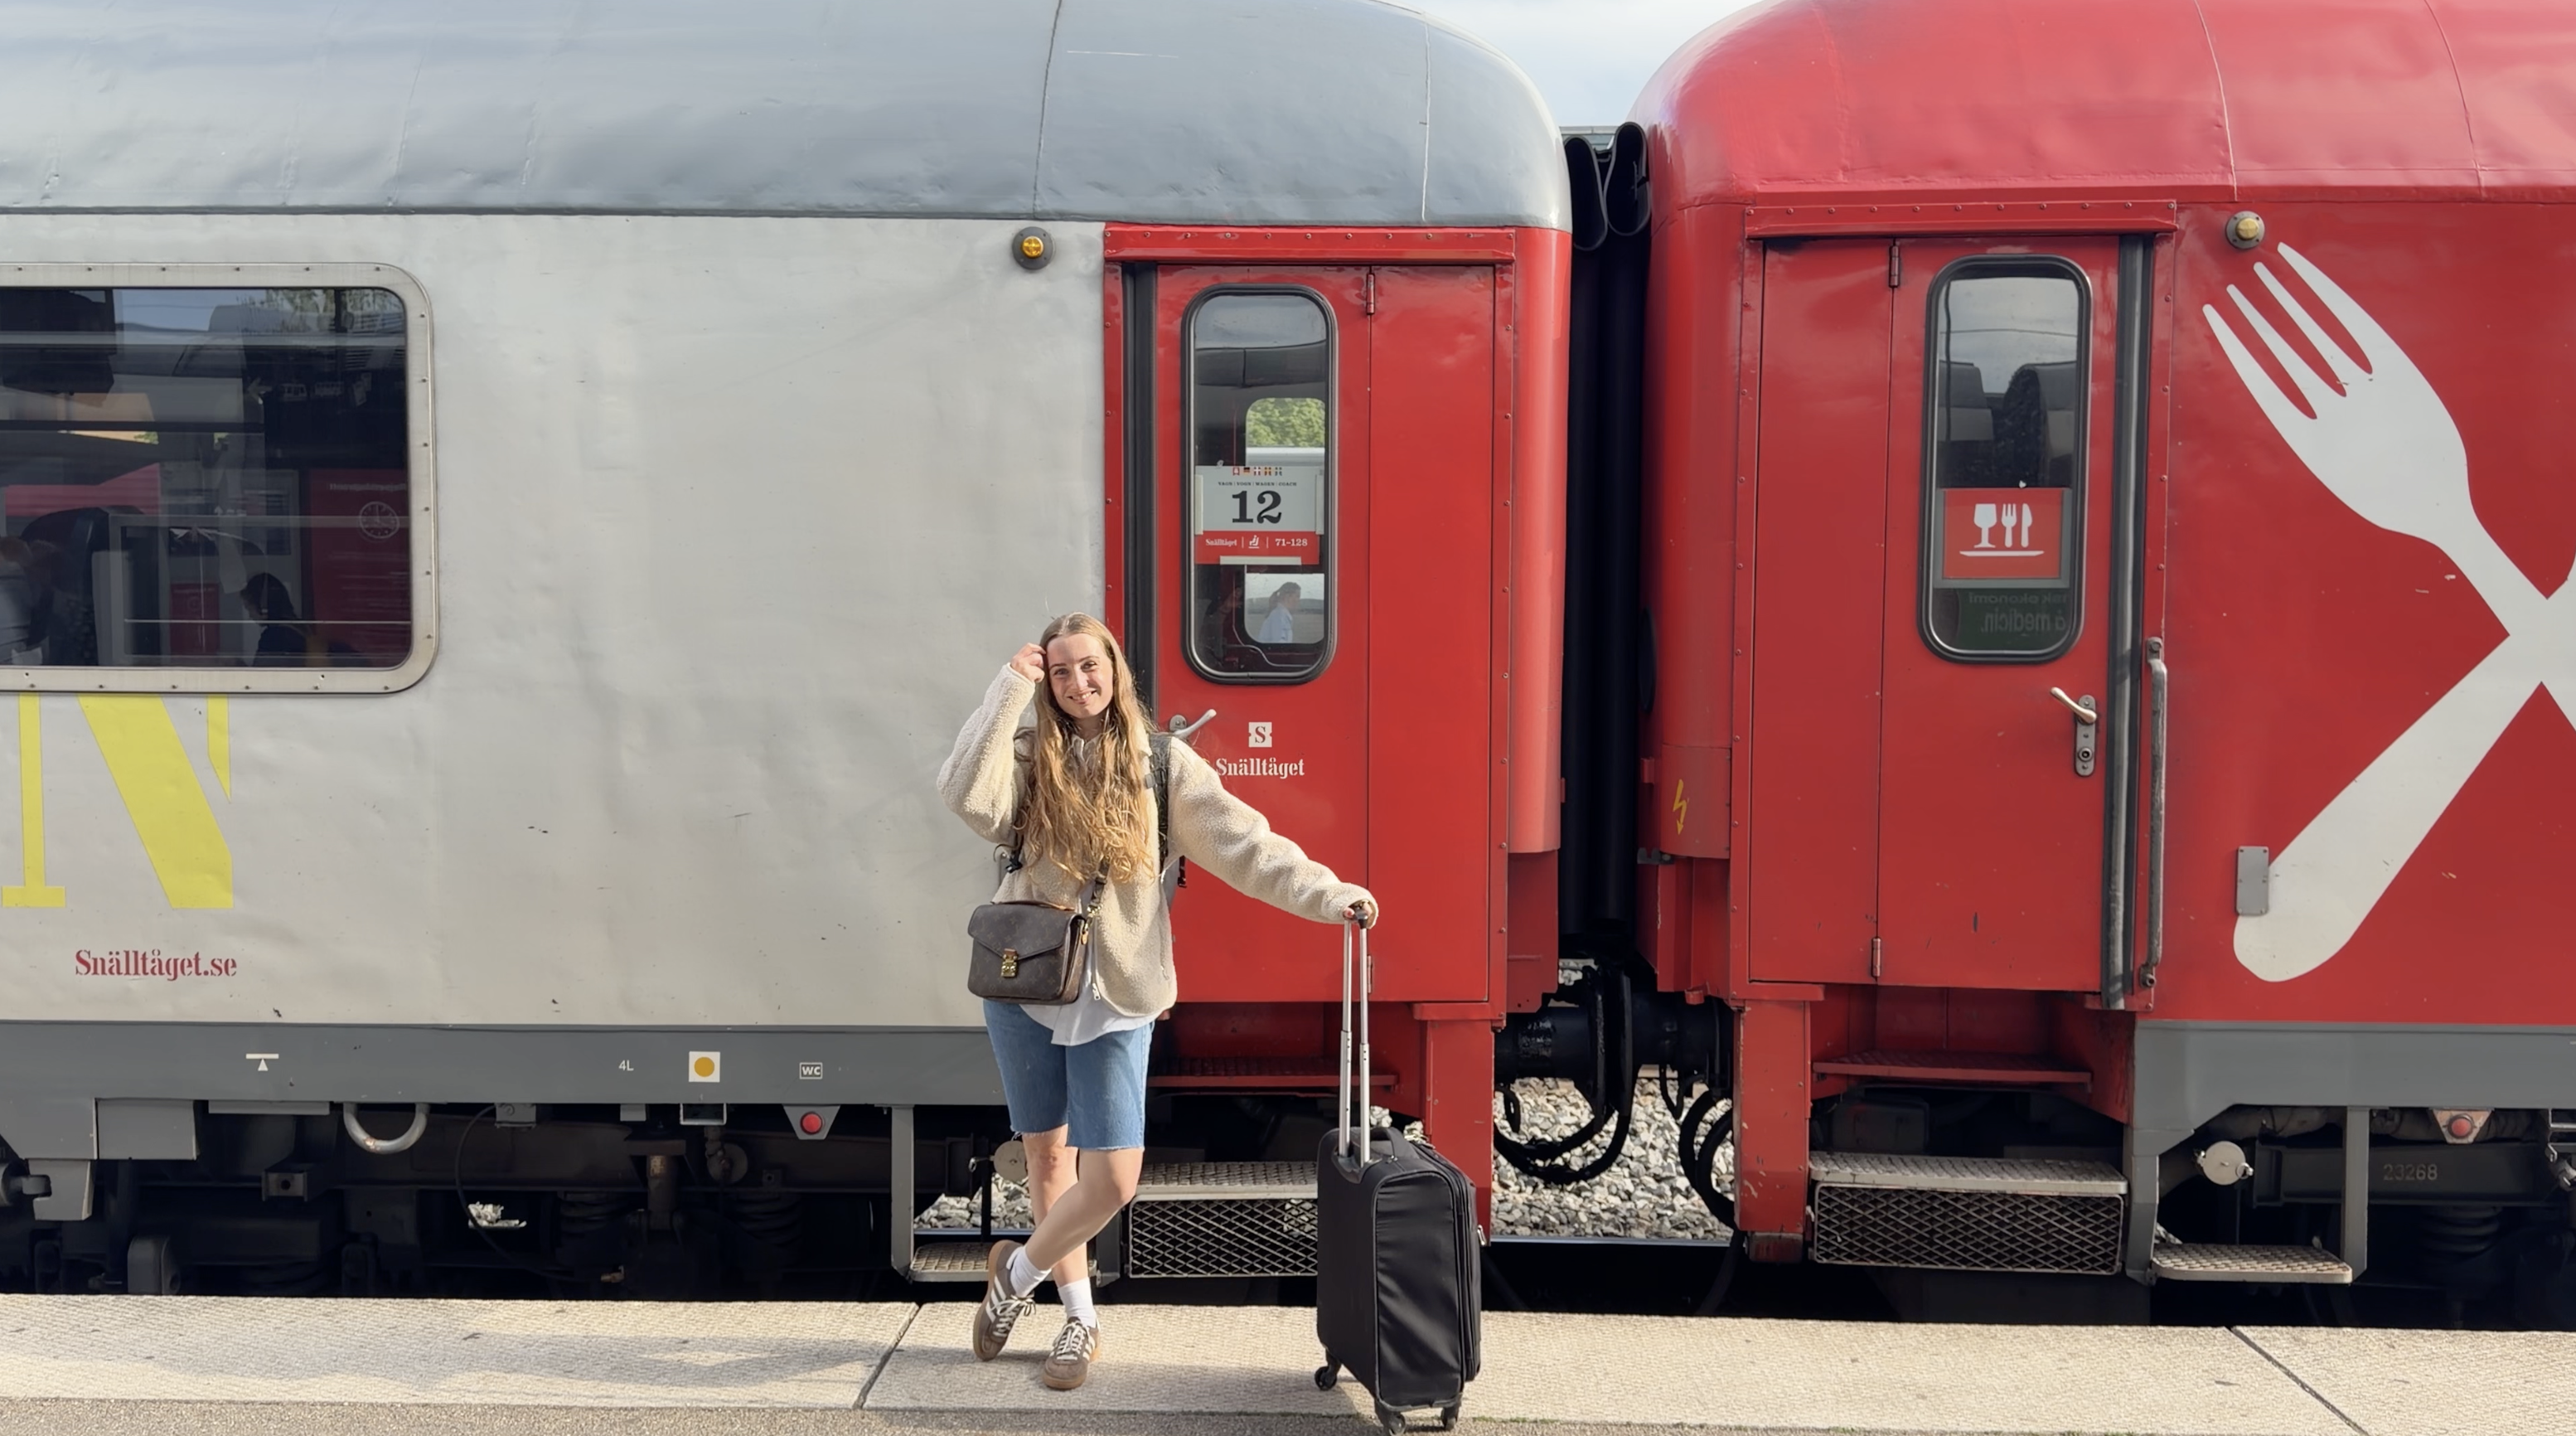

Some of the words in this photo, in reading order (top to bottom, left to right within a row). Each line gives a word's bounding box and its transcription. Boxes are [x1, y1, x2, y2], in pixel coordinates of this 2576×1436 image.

[1232, 490, 1282, 524] 12
[1275, 538, 1309, 547] 71-128
[1255, 725, 1266, 744] S
[1215, 758, 1305, 779] Snälltåget
[75, 948, 237, 980] Snälltåget.se
[618, 1060, 635, 1072] 4L
[801, 1065, 821, 1076] WC
[2383, 1163, 2438, 1181] 23268
